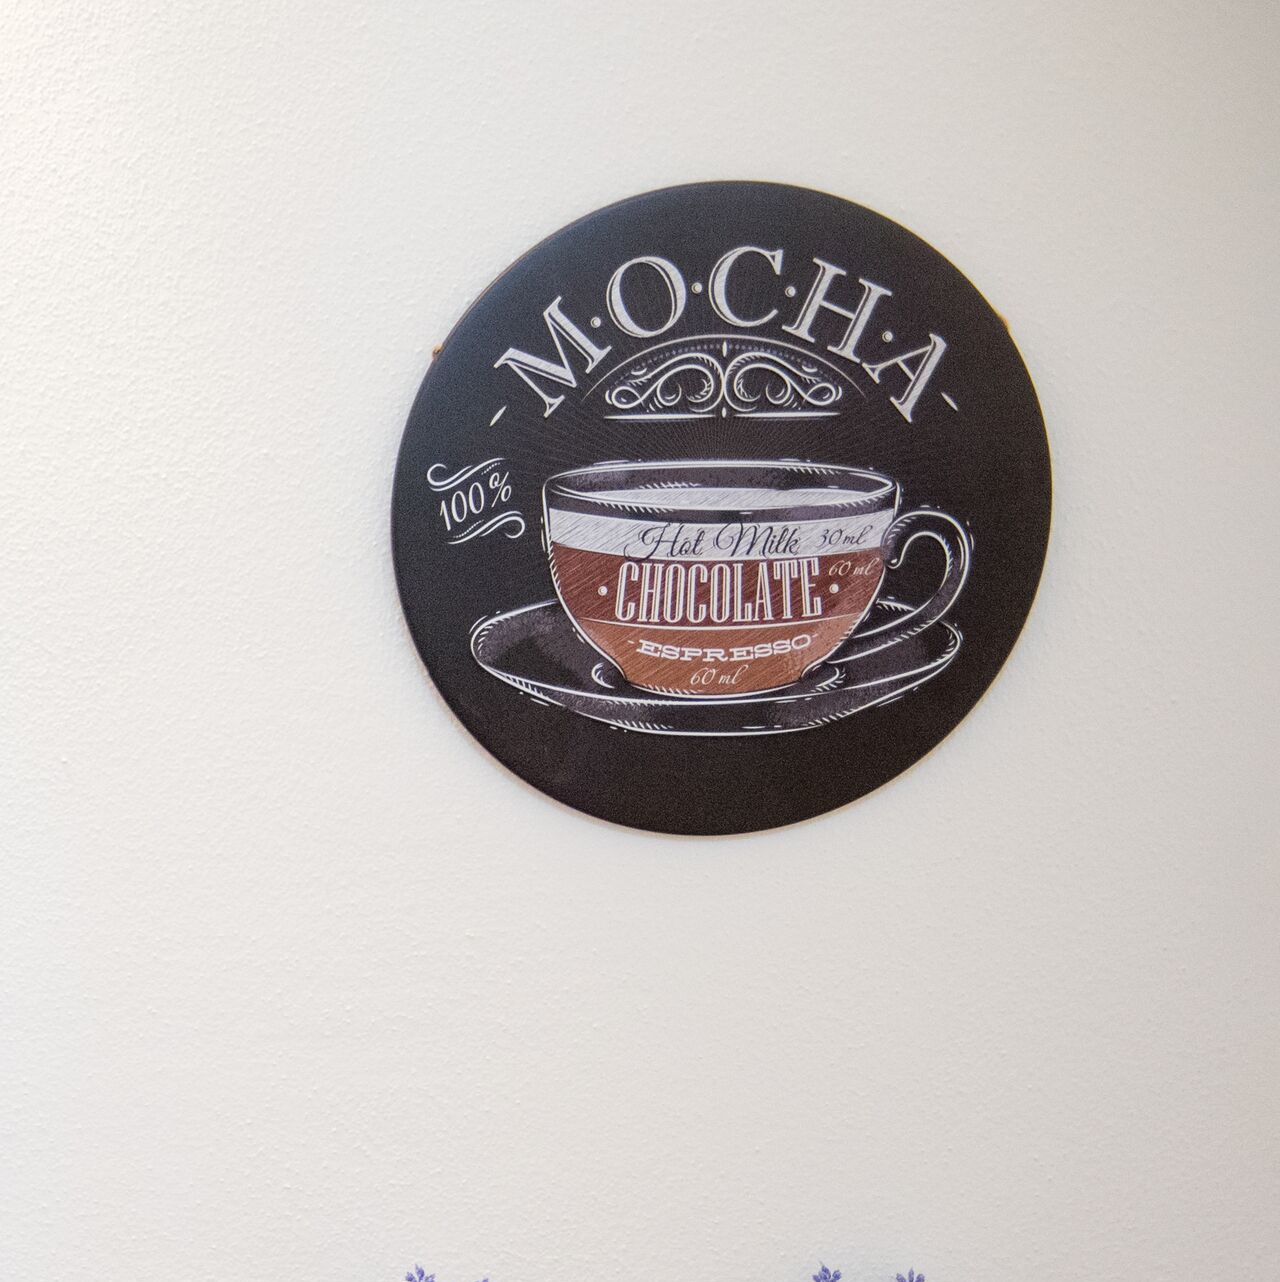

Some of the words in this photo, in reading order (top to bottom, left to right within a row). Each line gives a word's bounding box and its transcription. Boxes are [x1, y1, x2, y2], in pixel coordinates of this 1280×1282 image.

[438, 470, 511, 531] 100%
[624, 522, 704, 560] Hot
[713, 522, 801, 558] Milk
[615, 557, 822, 623] CHOCOLATE
[636, 634, 812, 662] ESPRESSO
